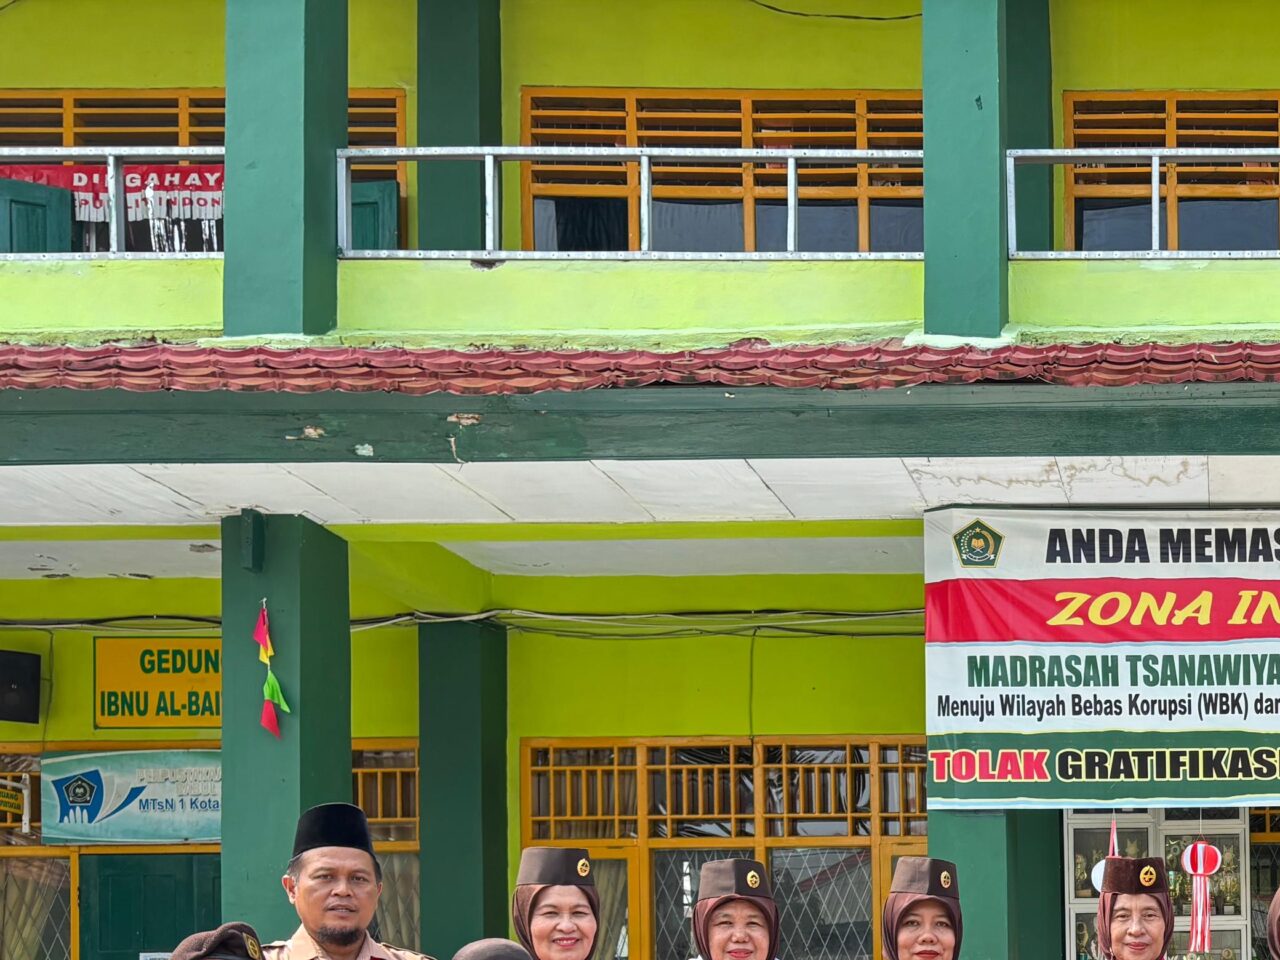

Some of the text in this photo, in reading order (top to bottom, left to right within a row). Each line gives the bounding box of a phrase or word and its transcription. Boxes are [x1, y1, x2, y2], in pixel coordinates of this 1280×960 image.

[1046, 528, 1150, 564] ANDA
[1046, 591, 1213, 626] ZONA
[140, 649, 222, 674] GEDUN
[967, 654, 1119, 688] MADRASAH
[100, 691, 221, 717] IBNU AL-BAI
[937, 694, 995, 722] Menuju
[999, 693, 1066, 722] Wilayah
[1071, 693, 1123, 716] Bebas
[1129, 693, 1192, 721] Korupsi
[1198, 692, 1249, 721] (WBK)
[929, 749, 1050, 782] TOLAK
[138, 798, 220, 811] MTsN 1 Kota
